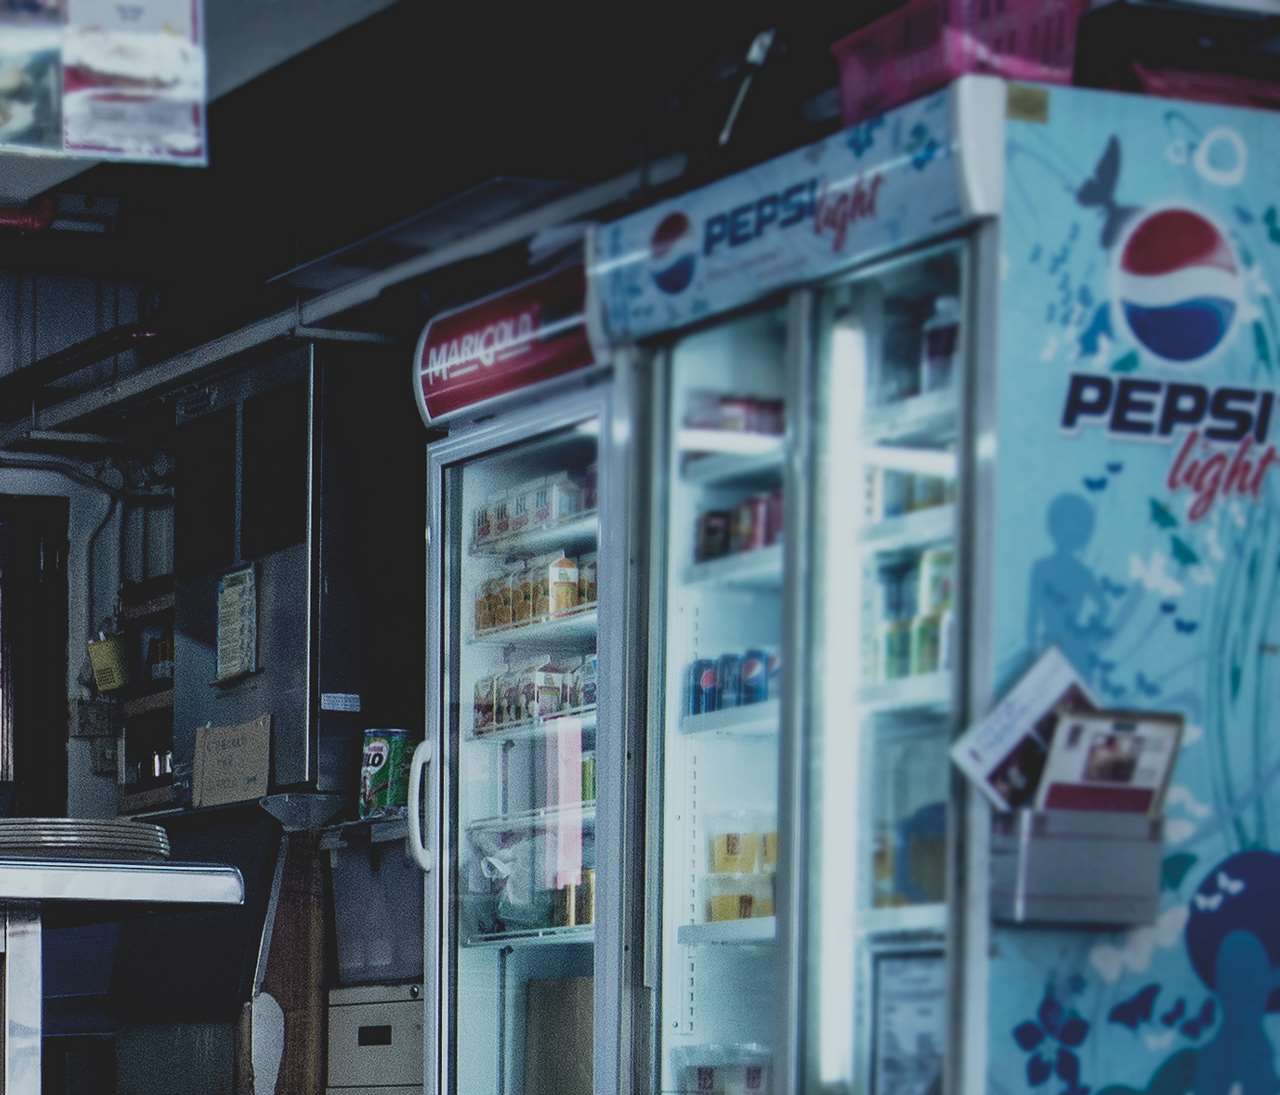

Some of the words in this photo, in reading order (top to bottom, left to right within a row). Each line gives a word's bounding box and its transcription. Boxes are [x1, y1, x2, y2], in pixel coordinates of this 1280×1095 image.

[703, 178, 819, 256] PEPSI
[812, 170, 887, 253] light
[428, 312, 536, 386] MARIGOLD
[1059, 373, 1276, 444] PEPSI
[1167, 430, 1280, 524] light
